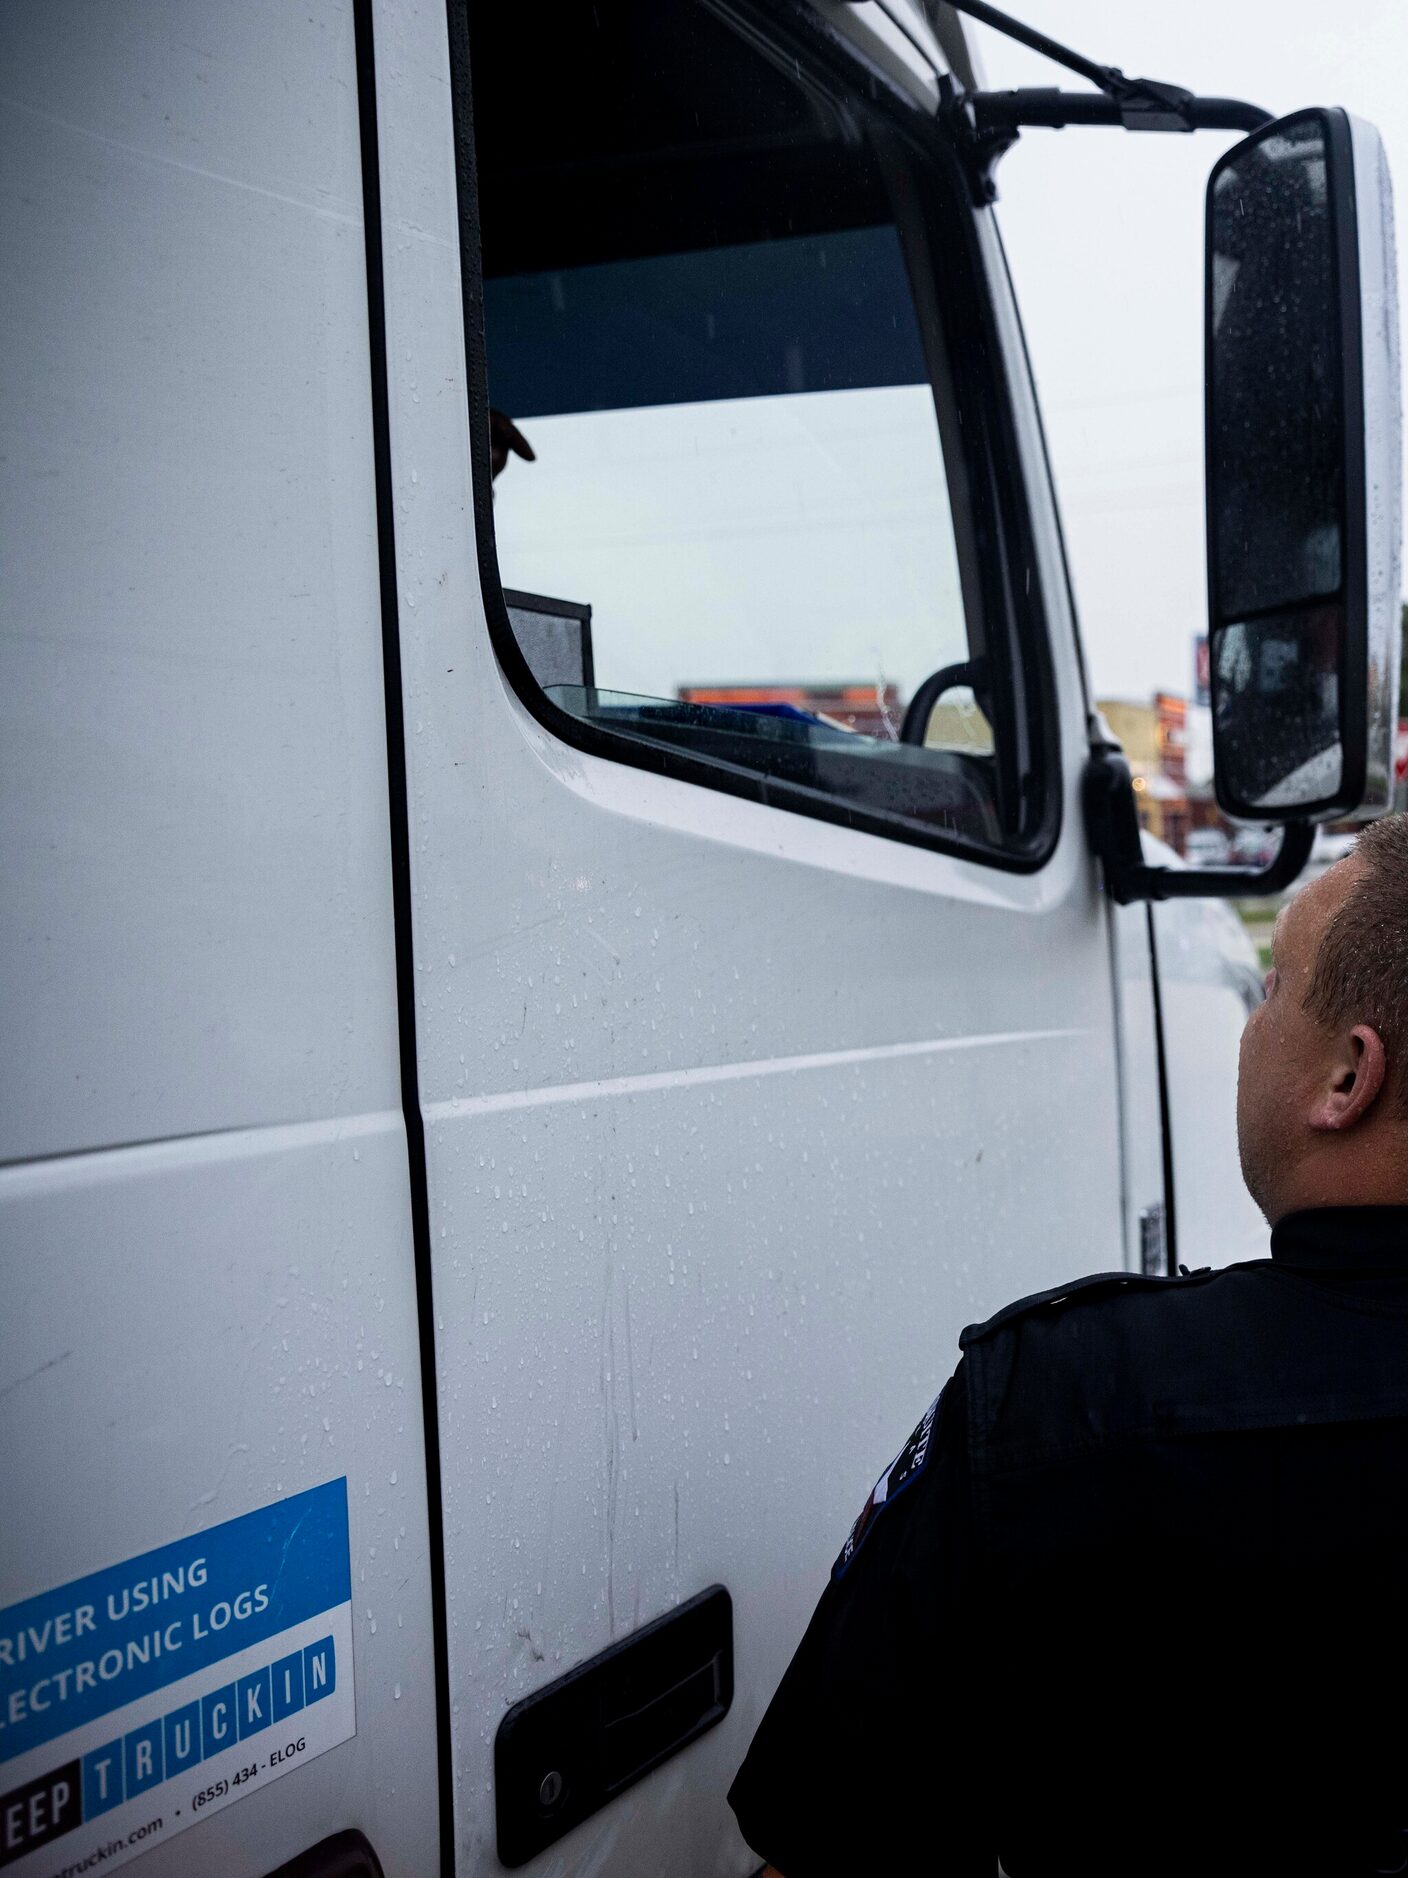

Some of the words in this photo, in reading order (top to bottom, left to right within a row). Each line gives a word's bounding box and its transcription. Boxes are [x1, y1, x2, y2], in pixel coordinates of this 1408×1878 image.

[0, 1621, 182, 1728] ECTRONIC
[193, 1584, 269, 1640] LOGS
[107, 1558, 208, 1621] USING
[53, 1818, 163, 1878] truckin.com
[192, 1779, 229, 1811] (855)
[232, 1763, 258, 1785] 434
[269, 1737, 306, 1767] ELOG
